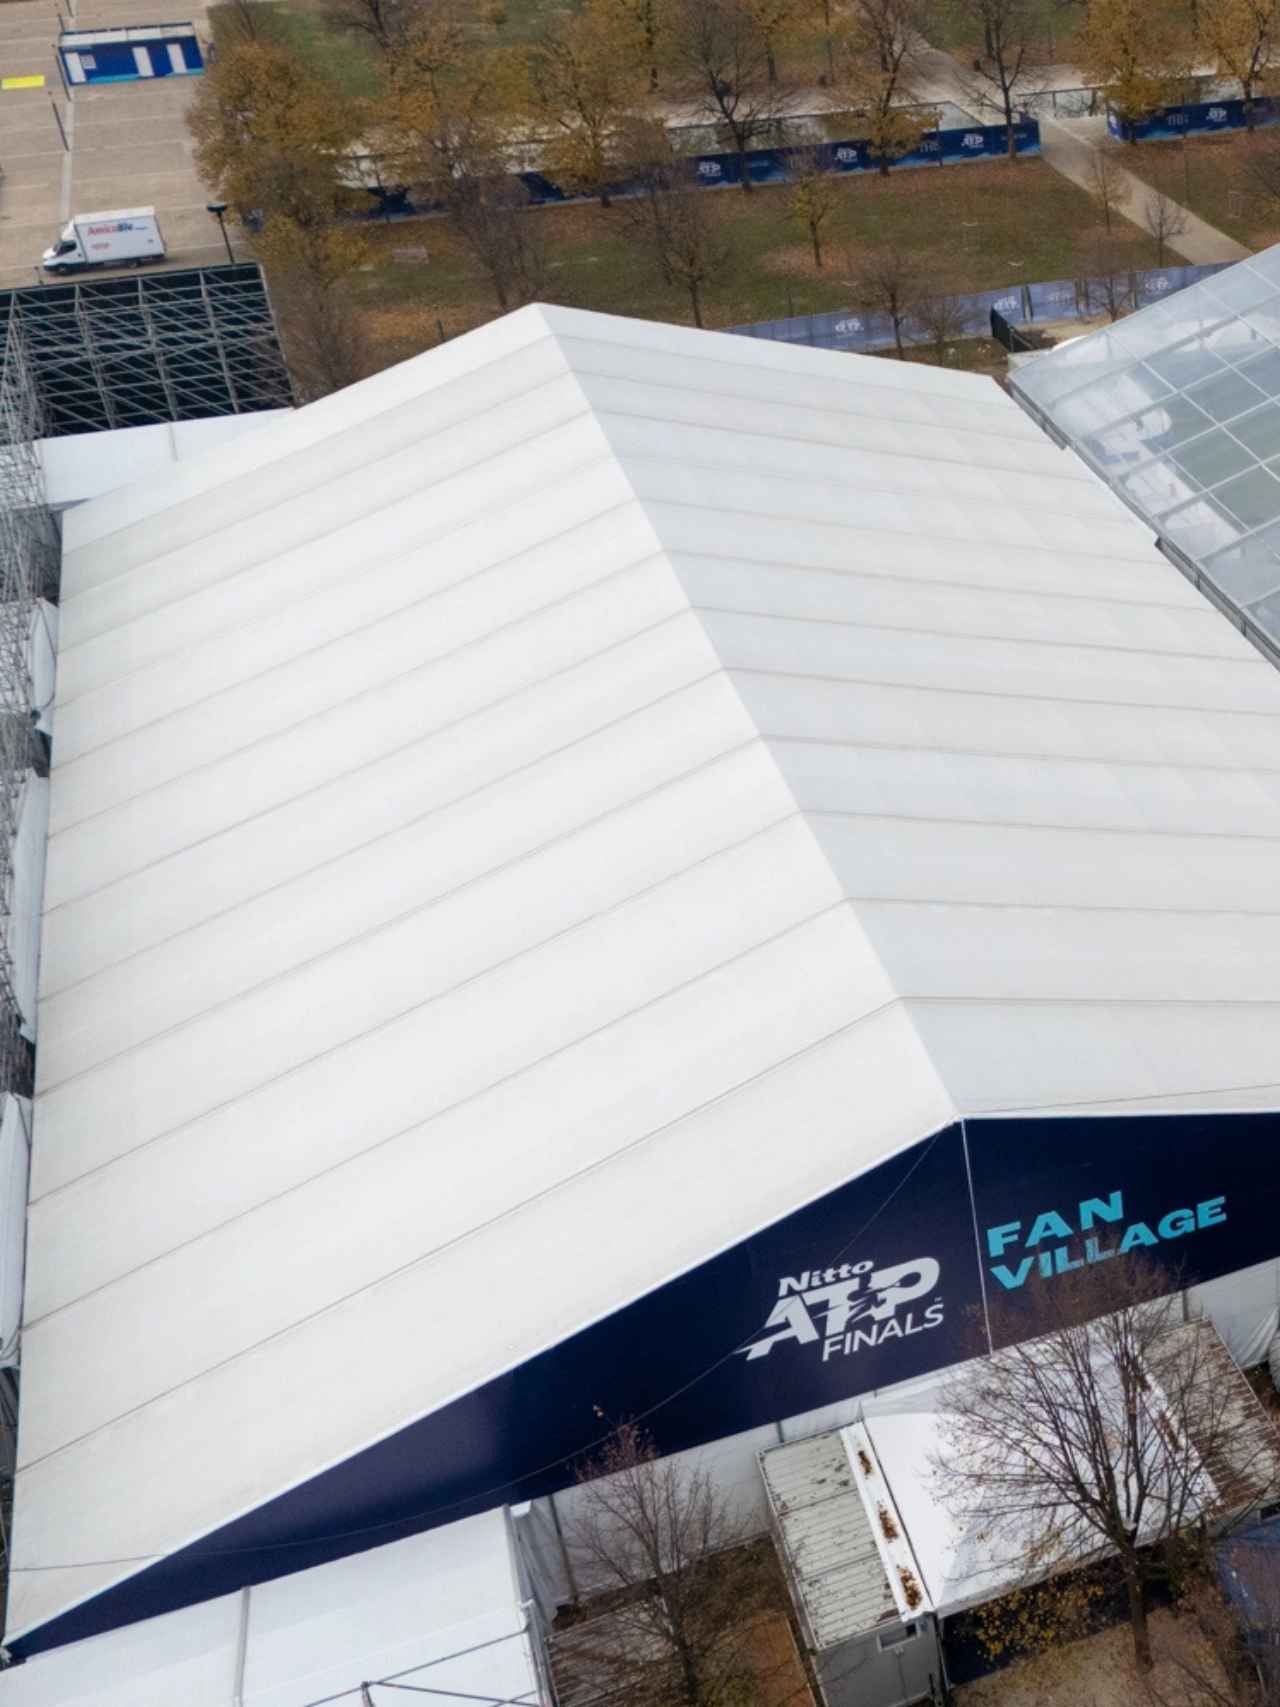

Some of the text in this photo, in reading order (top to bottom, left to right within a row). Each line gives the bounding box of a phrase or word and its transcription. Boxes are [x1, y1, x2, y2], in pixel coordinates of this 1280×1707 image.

[986, 1190, 1124, 1257] FAN
[991, 1196, 1227, 1290] VILLAGE
[738, 1257, 940, 1361] ATP
[778, 1261, 874, 1297] Nitto
[822, 1303, 944, 1362] FINALS
